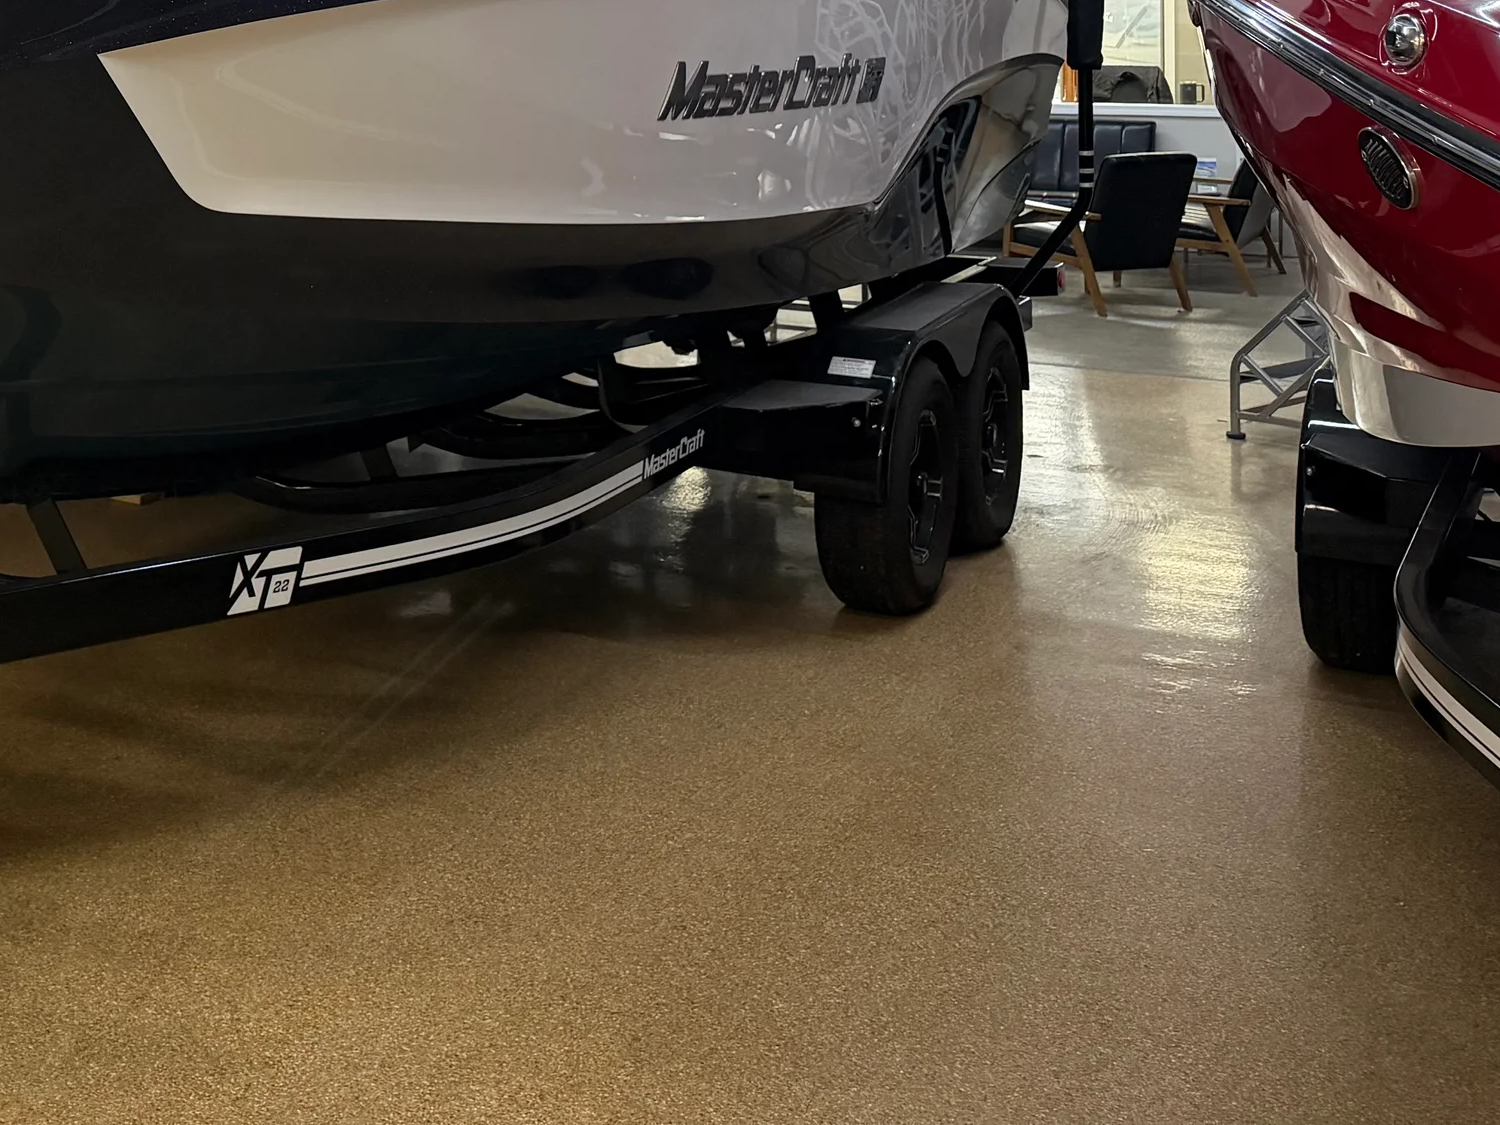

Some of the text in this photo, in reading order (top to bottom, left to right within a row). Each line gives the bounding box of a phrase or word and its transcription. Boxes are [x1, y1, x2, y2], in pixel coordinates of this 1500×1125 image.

[656, 53, 861, 122] MasterCraft
[643, 428, 706, 480] MasterCraft
[227, 548, 300, 614] XT
[272, 578, 290, 594] 22
